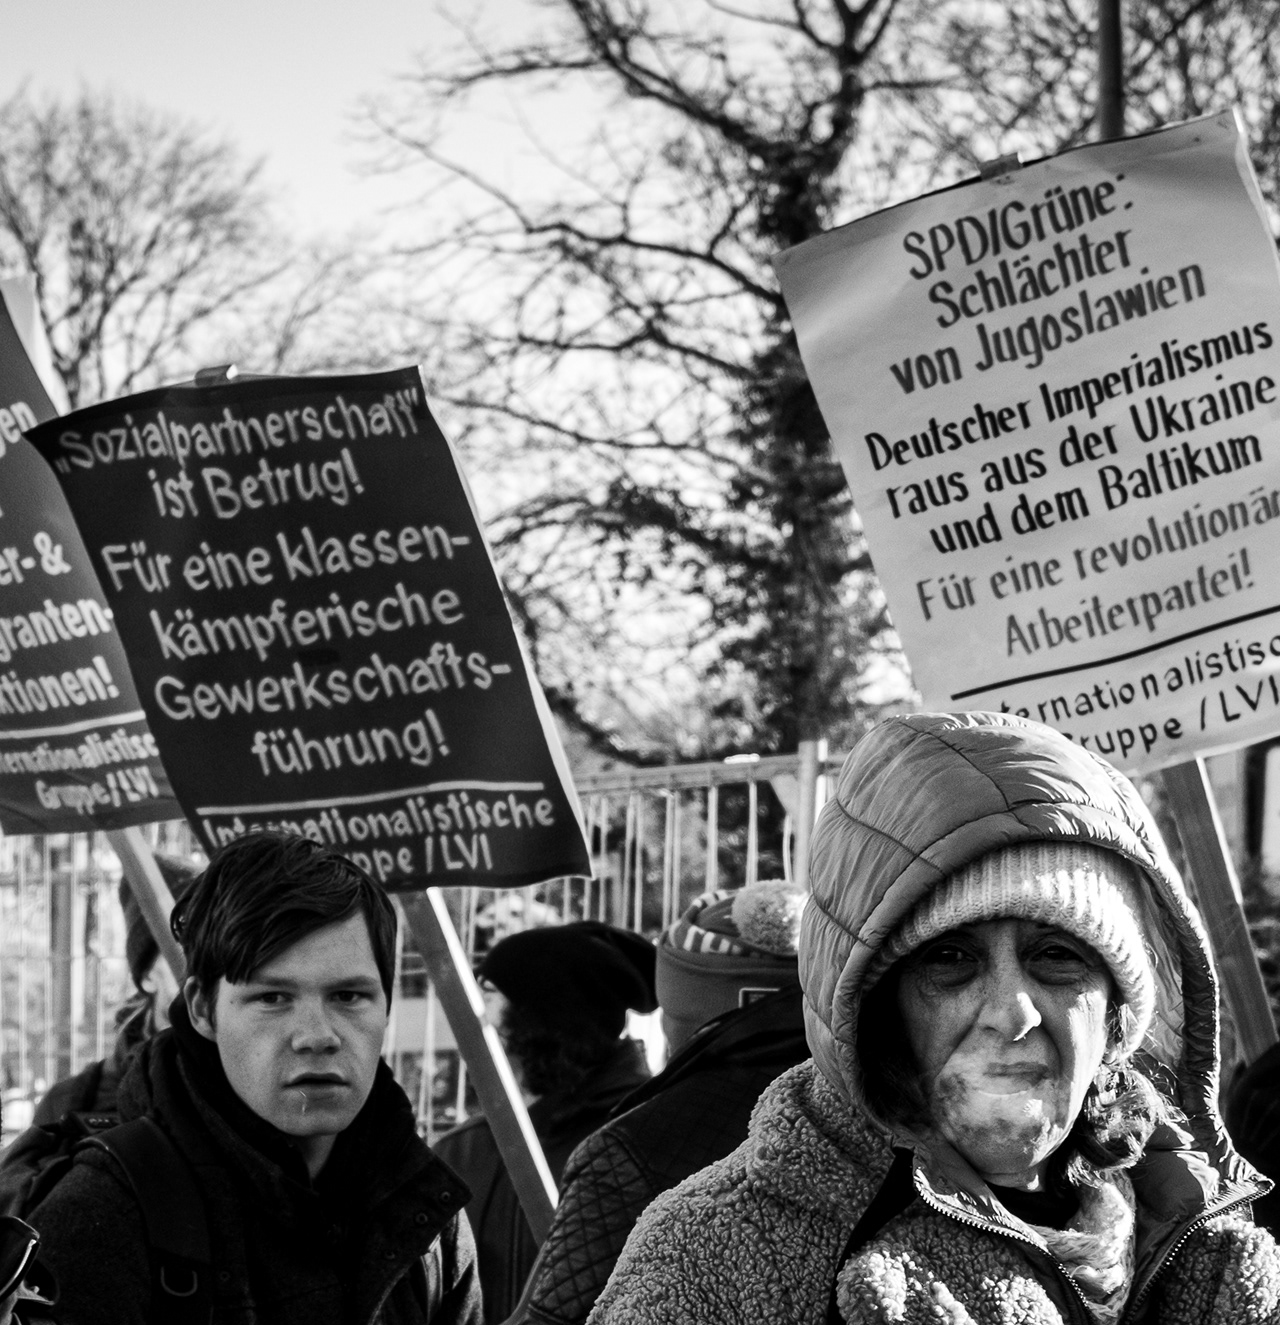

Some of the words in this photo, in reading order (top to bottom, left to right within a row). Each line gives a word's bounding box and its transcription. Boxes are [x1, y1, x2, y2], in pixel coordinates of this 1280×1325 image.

[927, 228, 1133, 329] Schlächter
[889, 340, 963, 395] von
[974, 263, 1206, 372] Jugoslawien
[864, 395, 1031, 471] Deutscher
[1040, 320, 1273, 423] Imperialismus
[149, 469, 199, 518] ist
[202, 448, 365, 519] Betrug!
[887, 468, 970, 520] raus
[983, 447, 1046, 490] aus
[1059, 420, 1119, 470] der
[1130, 373, 1277, 445] Ukraine
[929, 507, 1001, 554] und
[1011, 487, 1090, 535] dem
[1097, 434, 1263, 510] Baltikum
[102, 540, 171, 593] Für
[183, 542, 272, 591] eine
[280, 524, 470, 580] klassen-
[916, 569, 978, 620] Für
[989, 555, 1063, 599] eine
[150, 583, 463, 661] kämpferische
[1004, 548, 1255, 658] Arbeiterpartei!
[154, 642, 511, 720] Gewerkschafts-
[253, 709, 450, 776] führung!
[1063, 716, 1183, 758] ruppe
